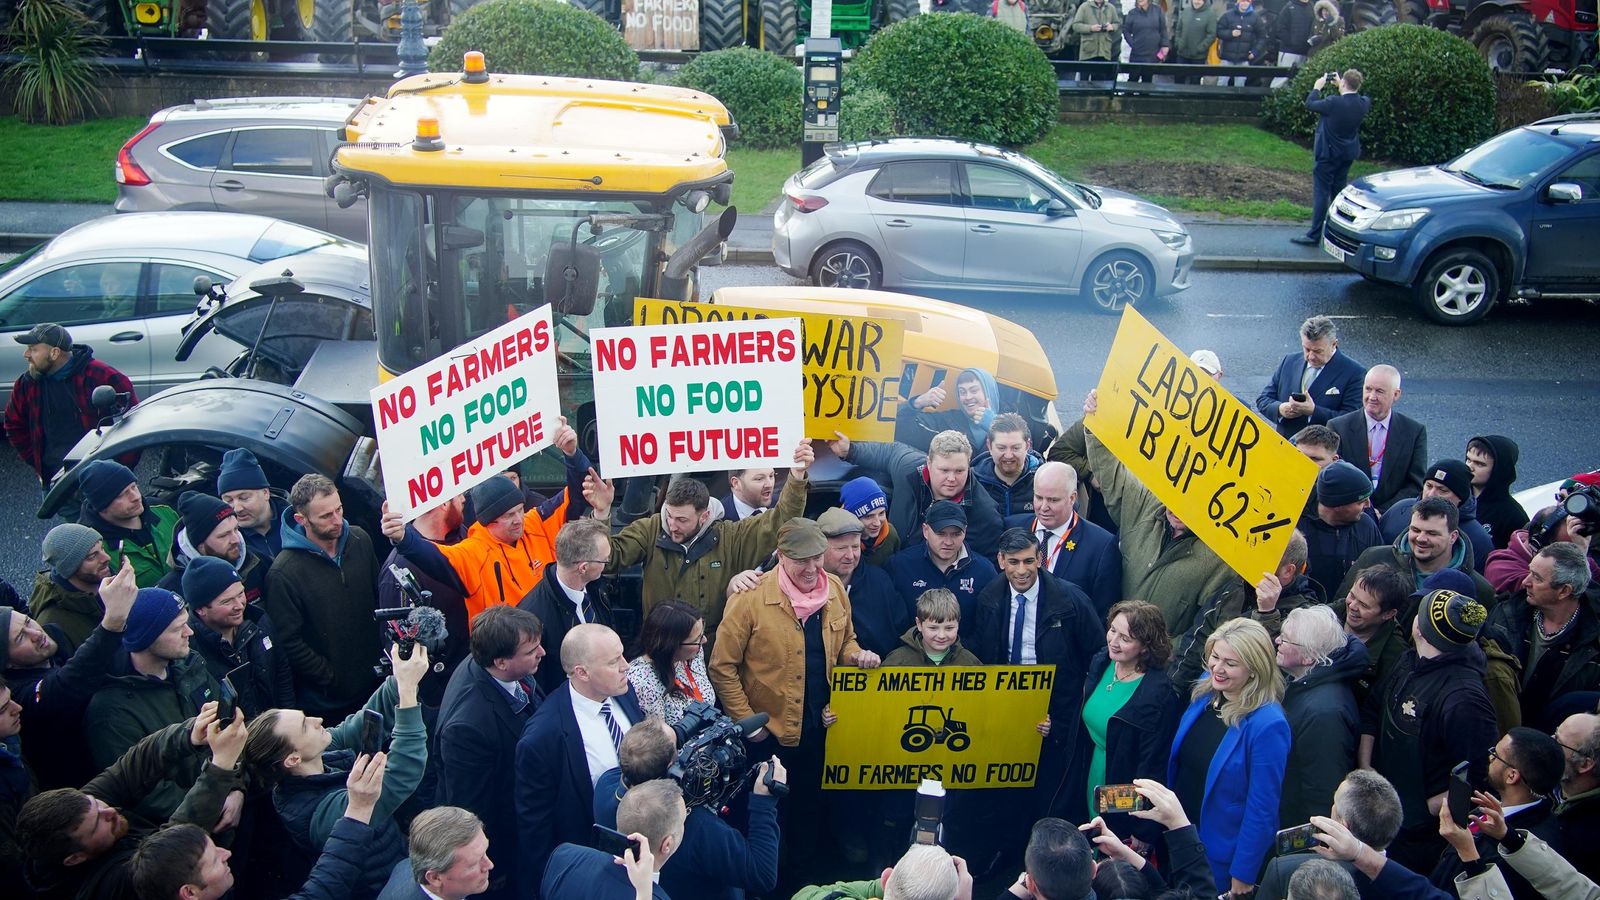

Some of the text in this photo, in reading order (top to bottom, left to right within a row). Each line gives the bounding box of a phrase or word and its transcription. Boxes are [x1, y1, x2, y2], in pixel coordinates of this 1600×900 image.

[626, 12, 647, 28] NO
[596, 328, 796, 372] NO FARMERS
[800, 317, 884, 372] WAR
[378, 319, 549, 430] NO FARMERS
[419, 376, 528, 456] NO FOOD
[636, 379, 763, 418] NO FOOD
[1136, 343, 1260, 478] LABOUR
[407, 411, 544, 509] NO FUTURE
[619, 426, 779, 466] NO FUTURE
[1126, 389, 1165, 461] TB
[1165, 435, 1207, 494] UP
[854, 503, 870, 518] LIVE
[832, 671, 1053, 692] HEB AMAETH HEB FAETH
[825, 763, 1036, 785] NO FARMERS NO FOOD
